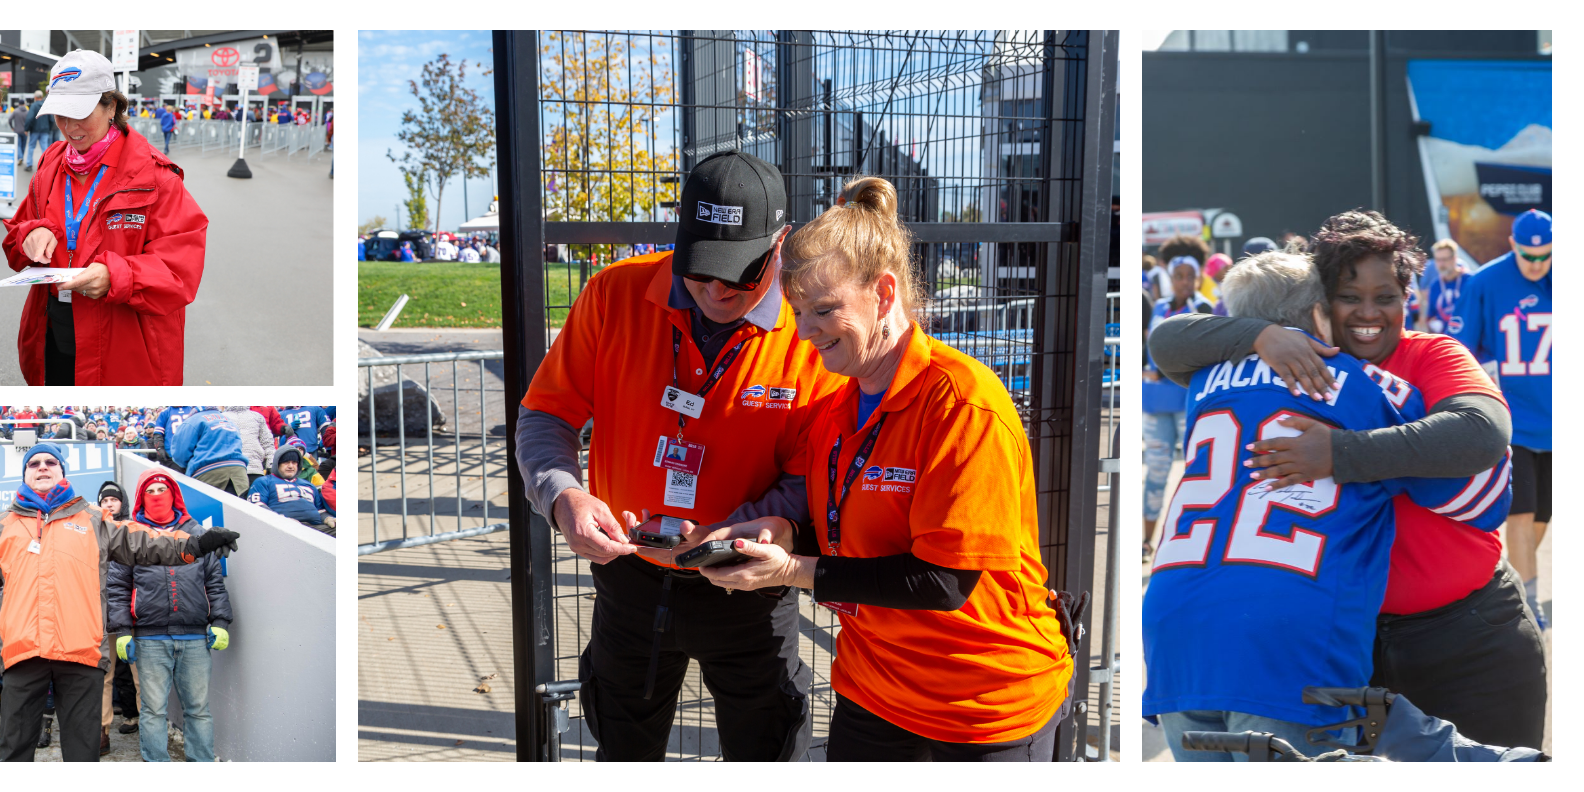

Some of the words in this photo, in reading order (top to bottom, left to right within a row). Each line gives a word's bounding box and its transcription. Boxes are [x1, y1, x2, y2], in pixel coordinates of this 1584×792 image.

[713, 213, 741, 223] FIELD
[1499, 313, 1552, 375] 17
[723, 352, 734, 365] BILLS
[686, 399, 695, 407] Ed
[742, 400, 763, 408] GUEST
[893, 473, 915, 481] FIELD
[862, 484, 878, 492] GUEST
[880, 484, 911, 493] SERVICES
[1152, 409, 1342, 579] 22
[171, 581, 179, 612] BILLS
